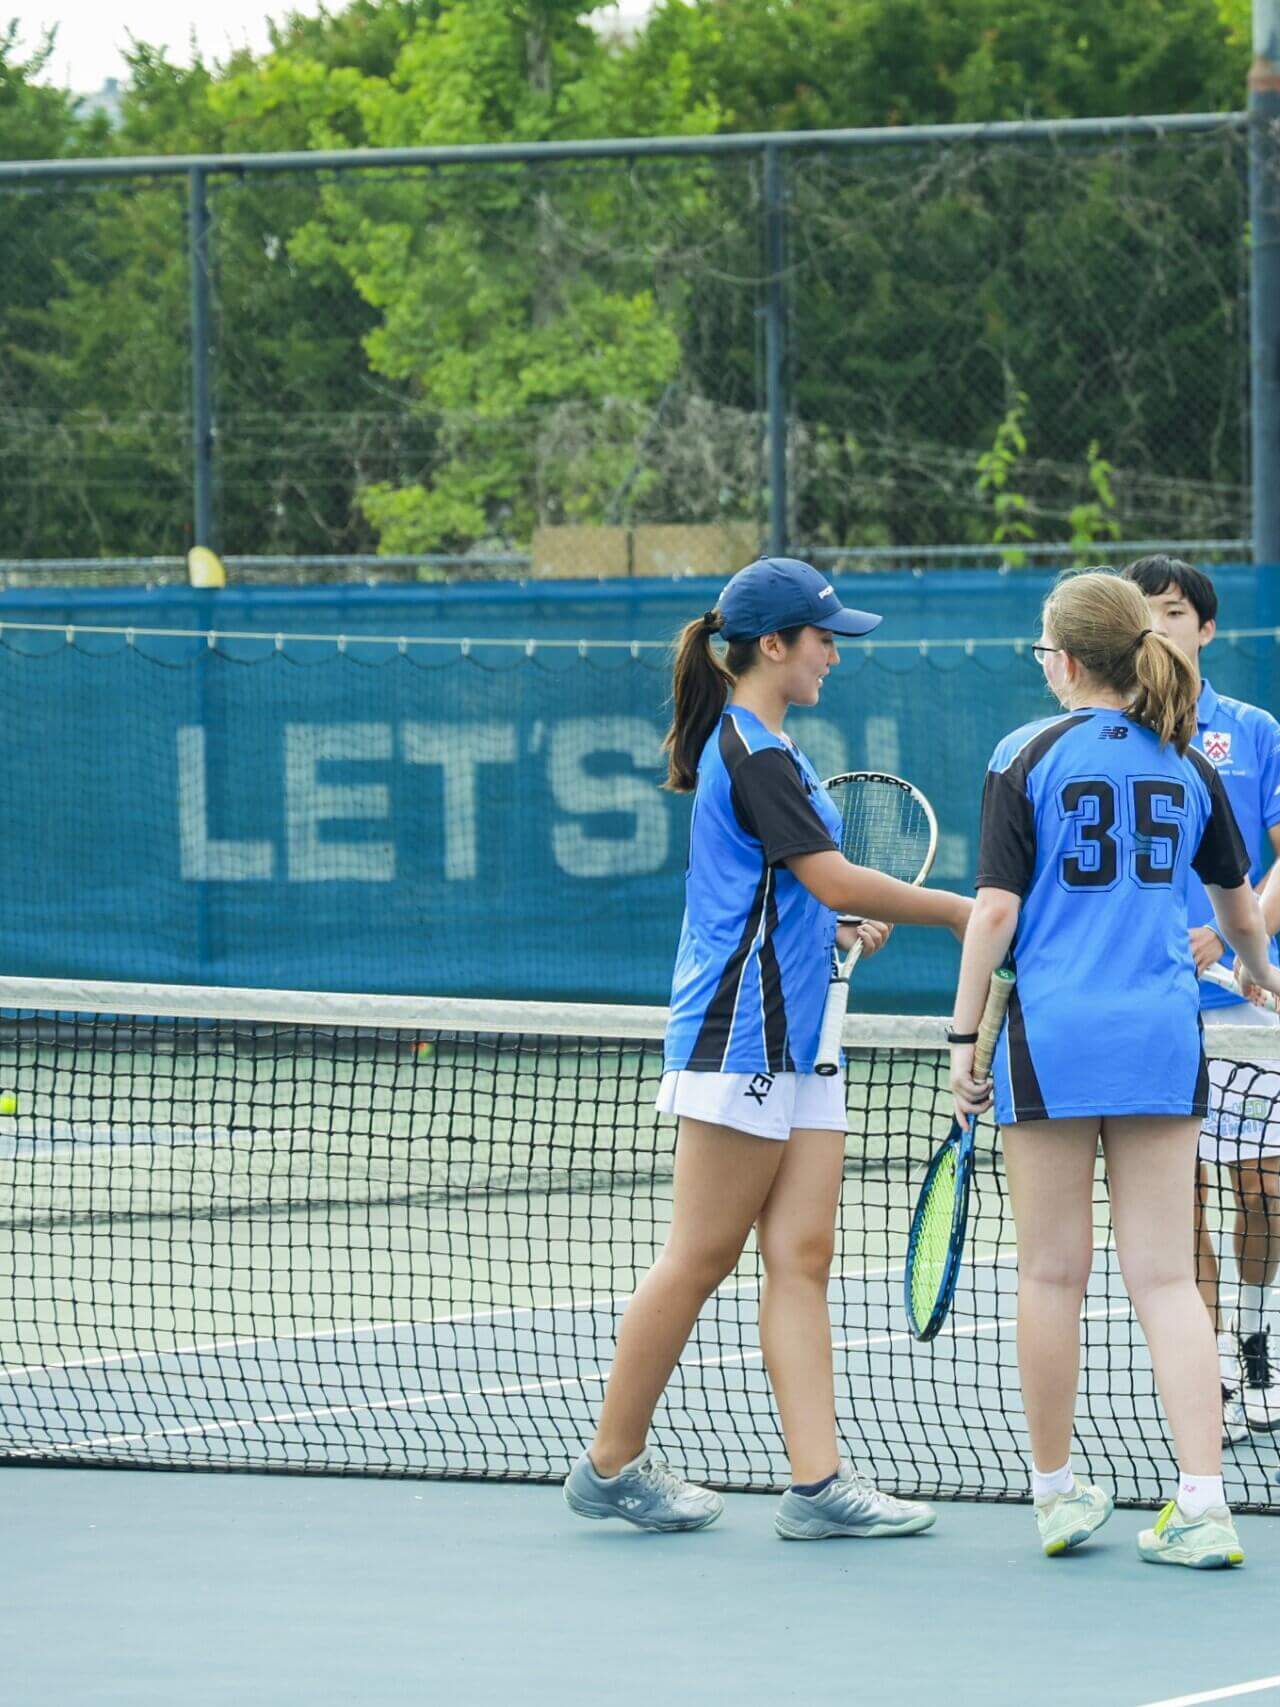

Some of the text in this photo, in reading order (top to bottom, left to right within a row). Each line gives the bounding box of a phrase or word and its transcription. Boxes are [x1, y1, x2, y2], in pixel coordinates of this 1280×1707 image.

[176, 716, 669, 882] LET'S
[1055, 774, 1187, 892] 35
[744, 1071, 776, 1106] EX
